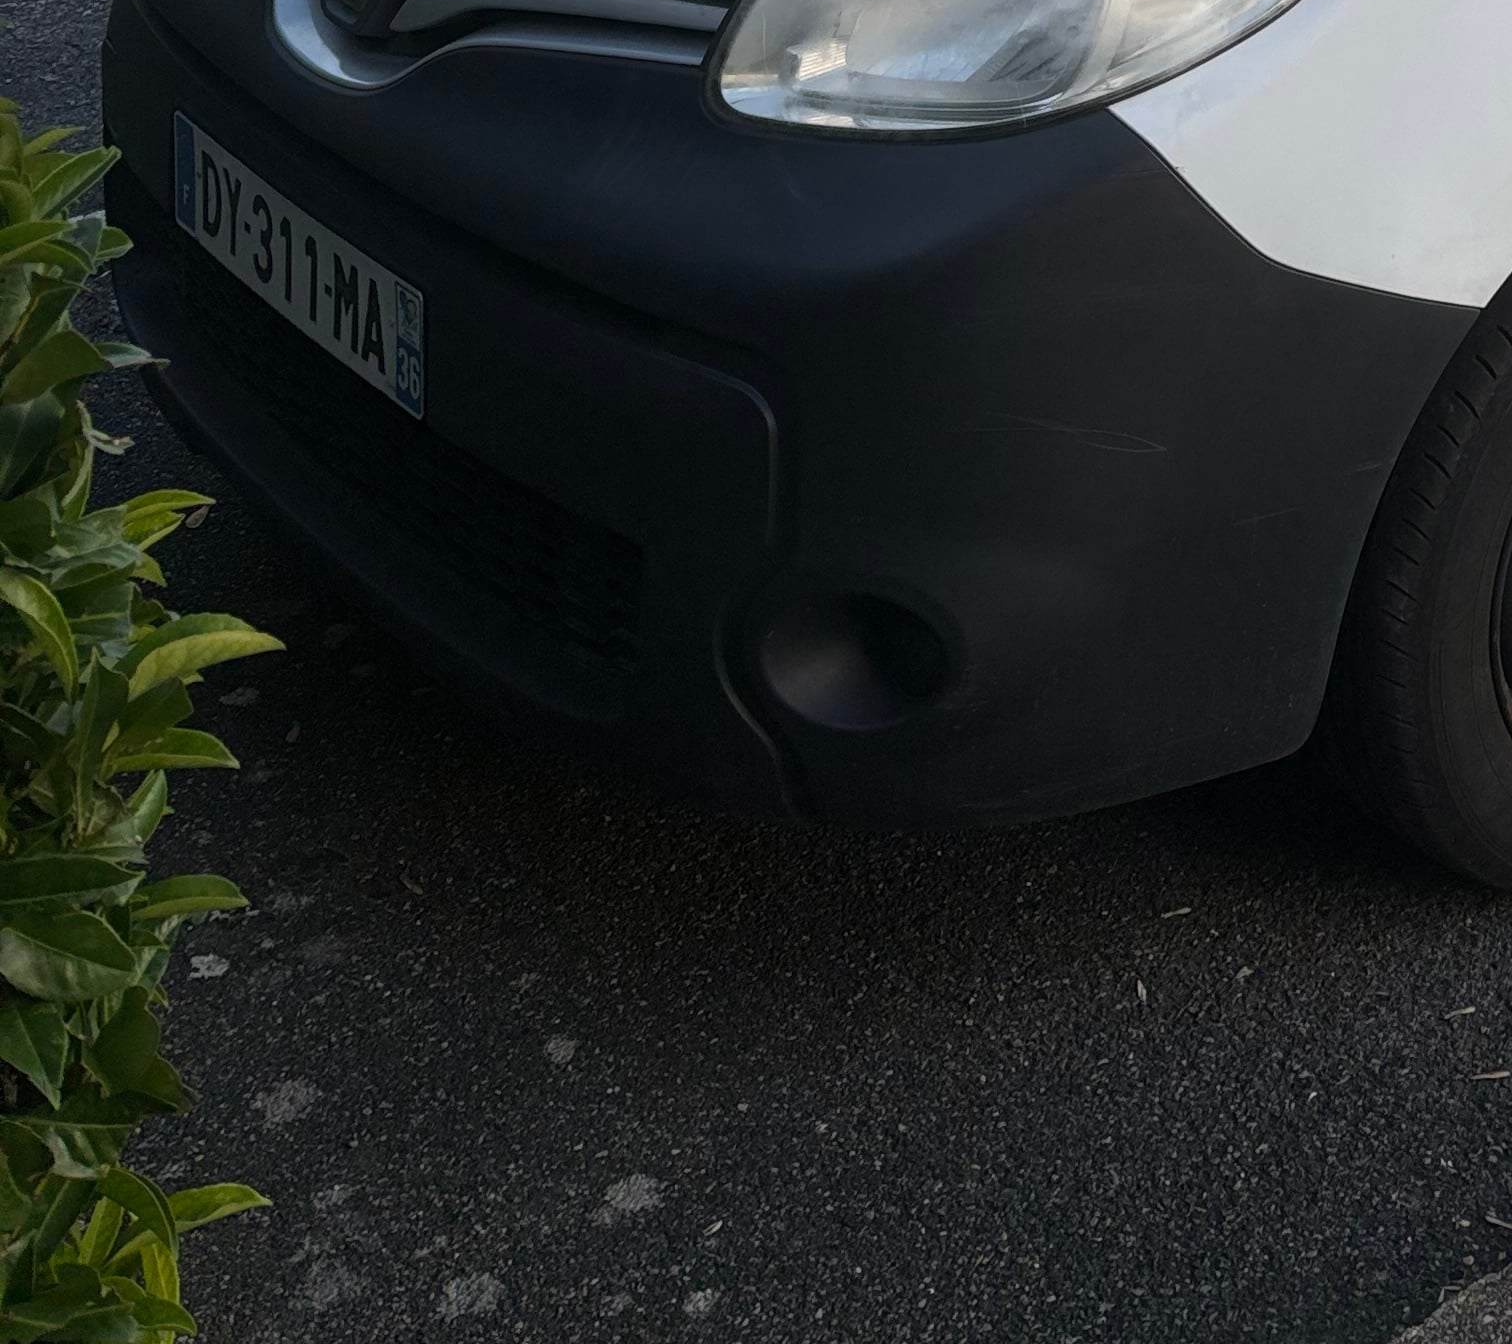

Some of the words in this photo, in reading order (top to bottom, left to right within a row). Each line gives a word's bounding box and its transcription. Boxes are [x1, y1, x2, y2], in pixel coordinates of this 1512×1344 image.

[183, 184, 191, 205] F
[201, 150, 386, 376] DY-311-MA
[398, 349, 421, 400] 36
